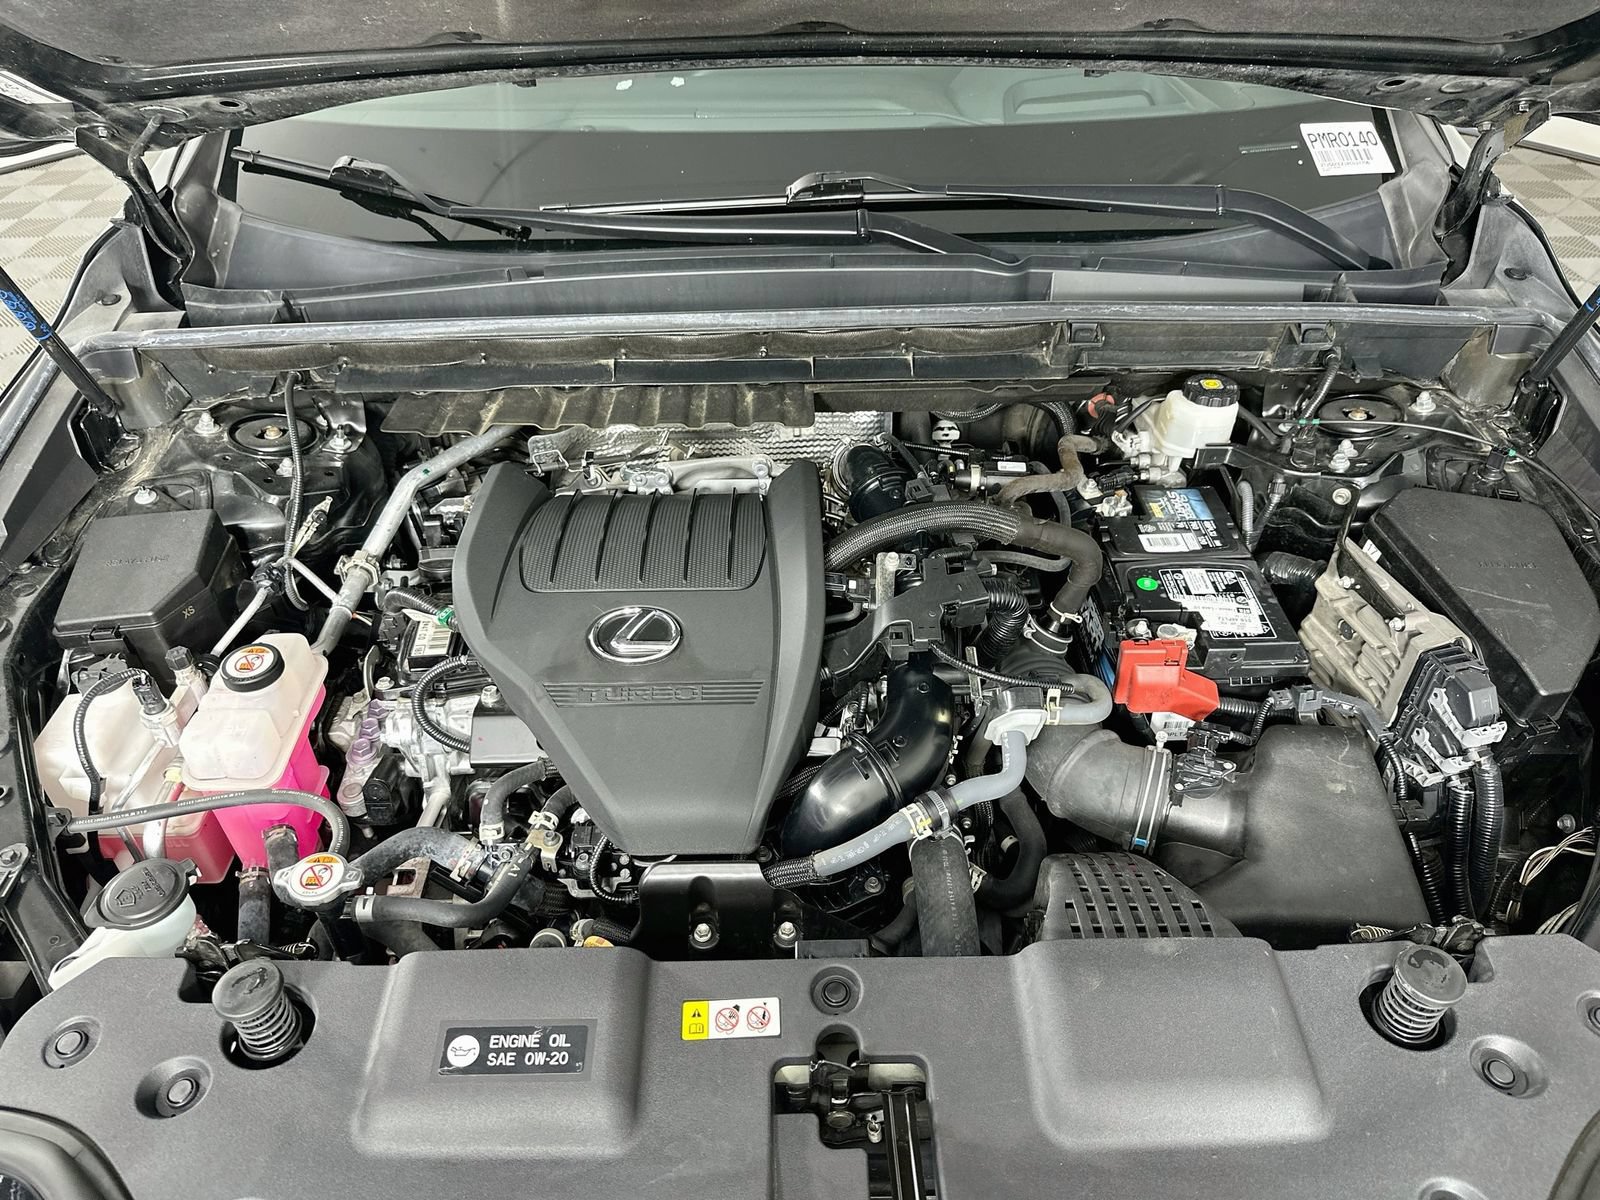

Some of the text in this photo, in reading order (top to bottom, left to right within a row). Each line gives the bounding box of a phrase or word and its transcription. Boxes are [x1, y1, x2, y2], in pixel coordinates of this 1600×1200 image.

[1307, 131, 1378, 149] PMR0140
[182, 605, 196, 619] XS
[577, 686, 699, 702] TURBO
[489, 1033, 571, 1049] ENGINE OIL
[487, 1051, 569, 1066] SAE 0W-20
